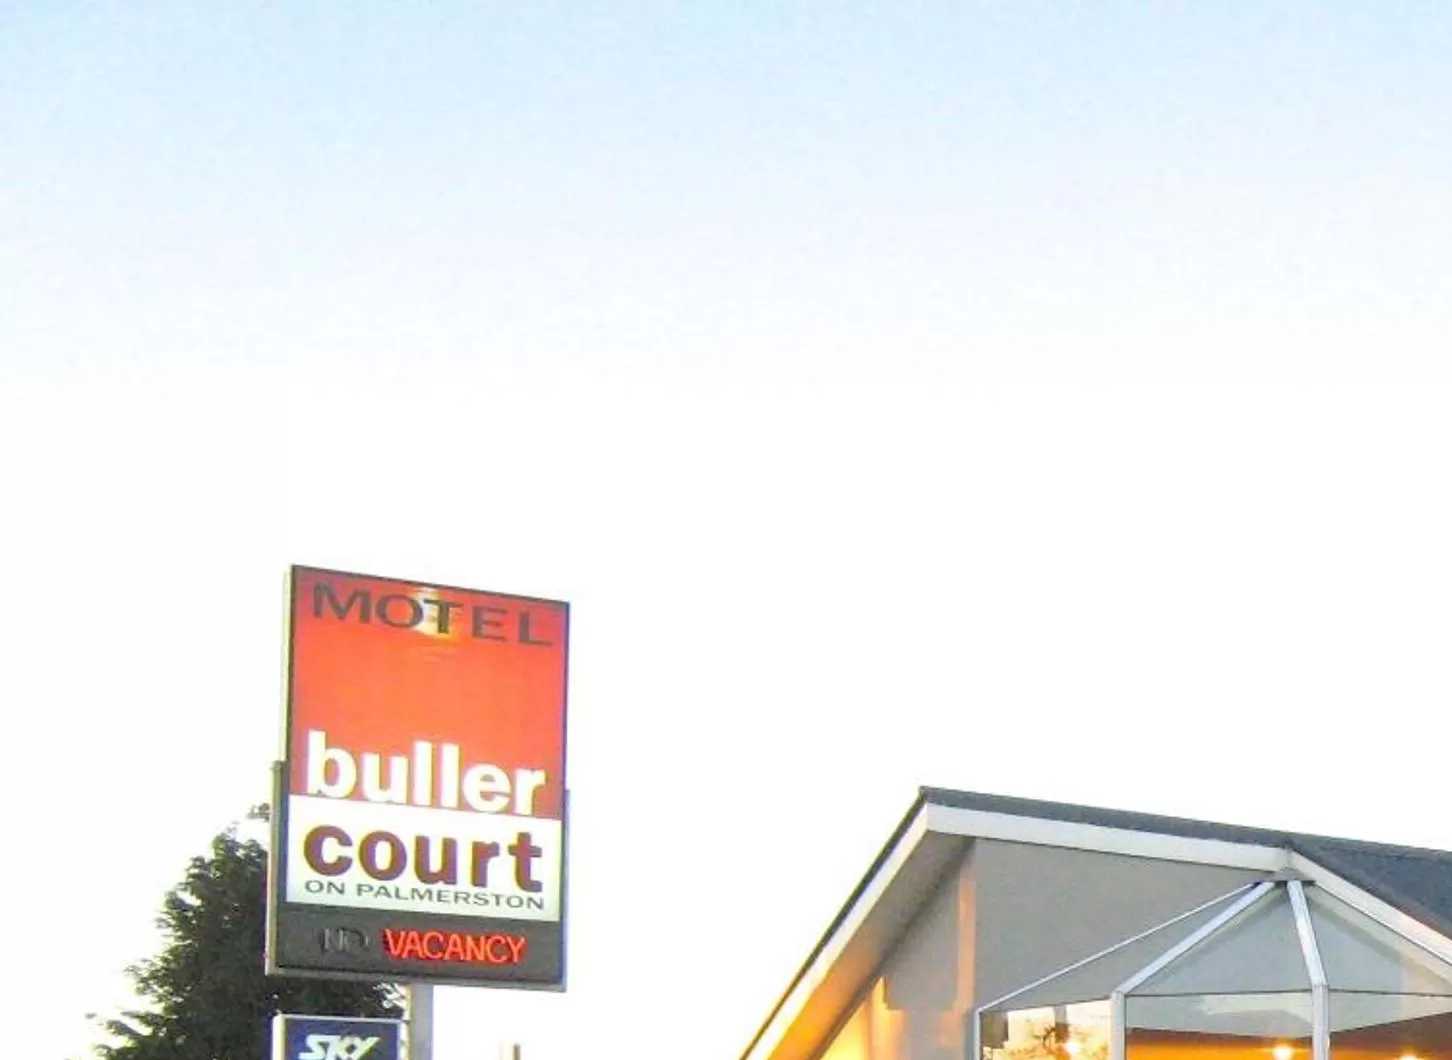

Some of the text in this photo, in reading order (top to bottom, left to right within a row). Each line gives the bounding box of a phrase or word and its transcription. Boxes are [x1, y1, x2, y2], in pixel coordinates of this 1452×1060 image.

[312, 583, 553, 647] MOTEL
[307, 729, 546, 817] buller
[304, 825, 544, 893] court
[304, 879, 545, 910] ON PALMERSTON
[384, 927, 526, 964] VACANCY
